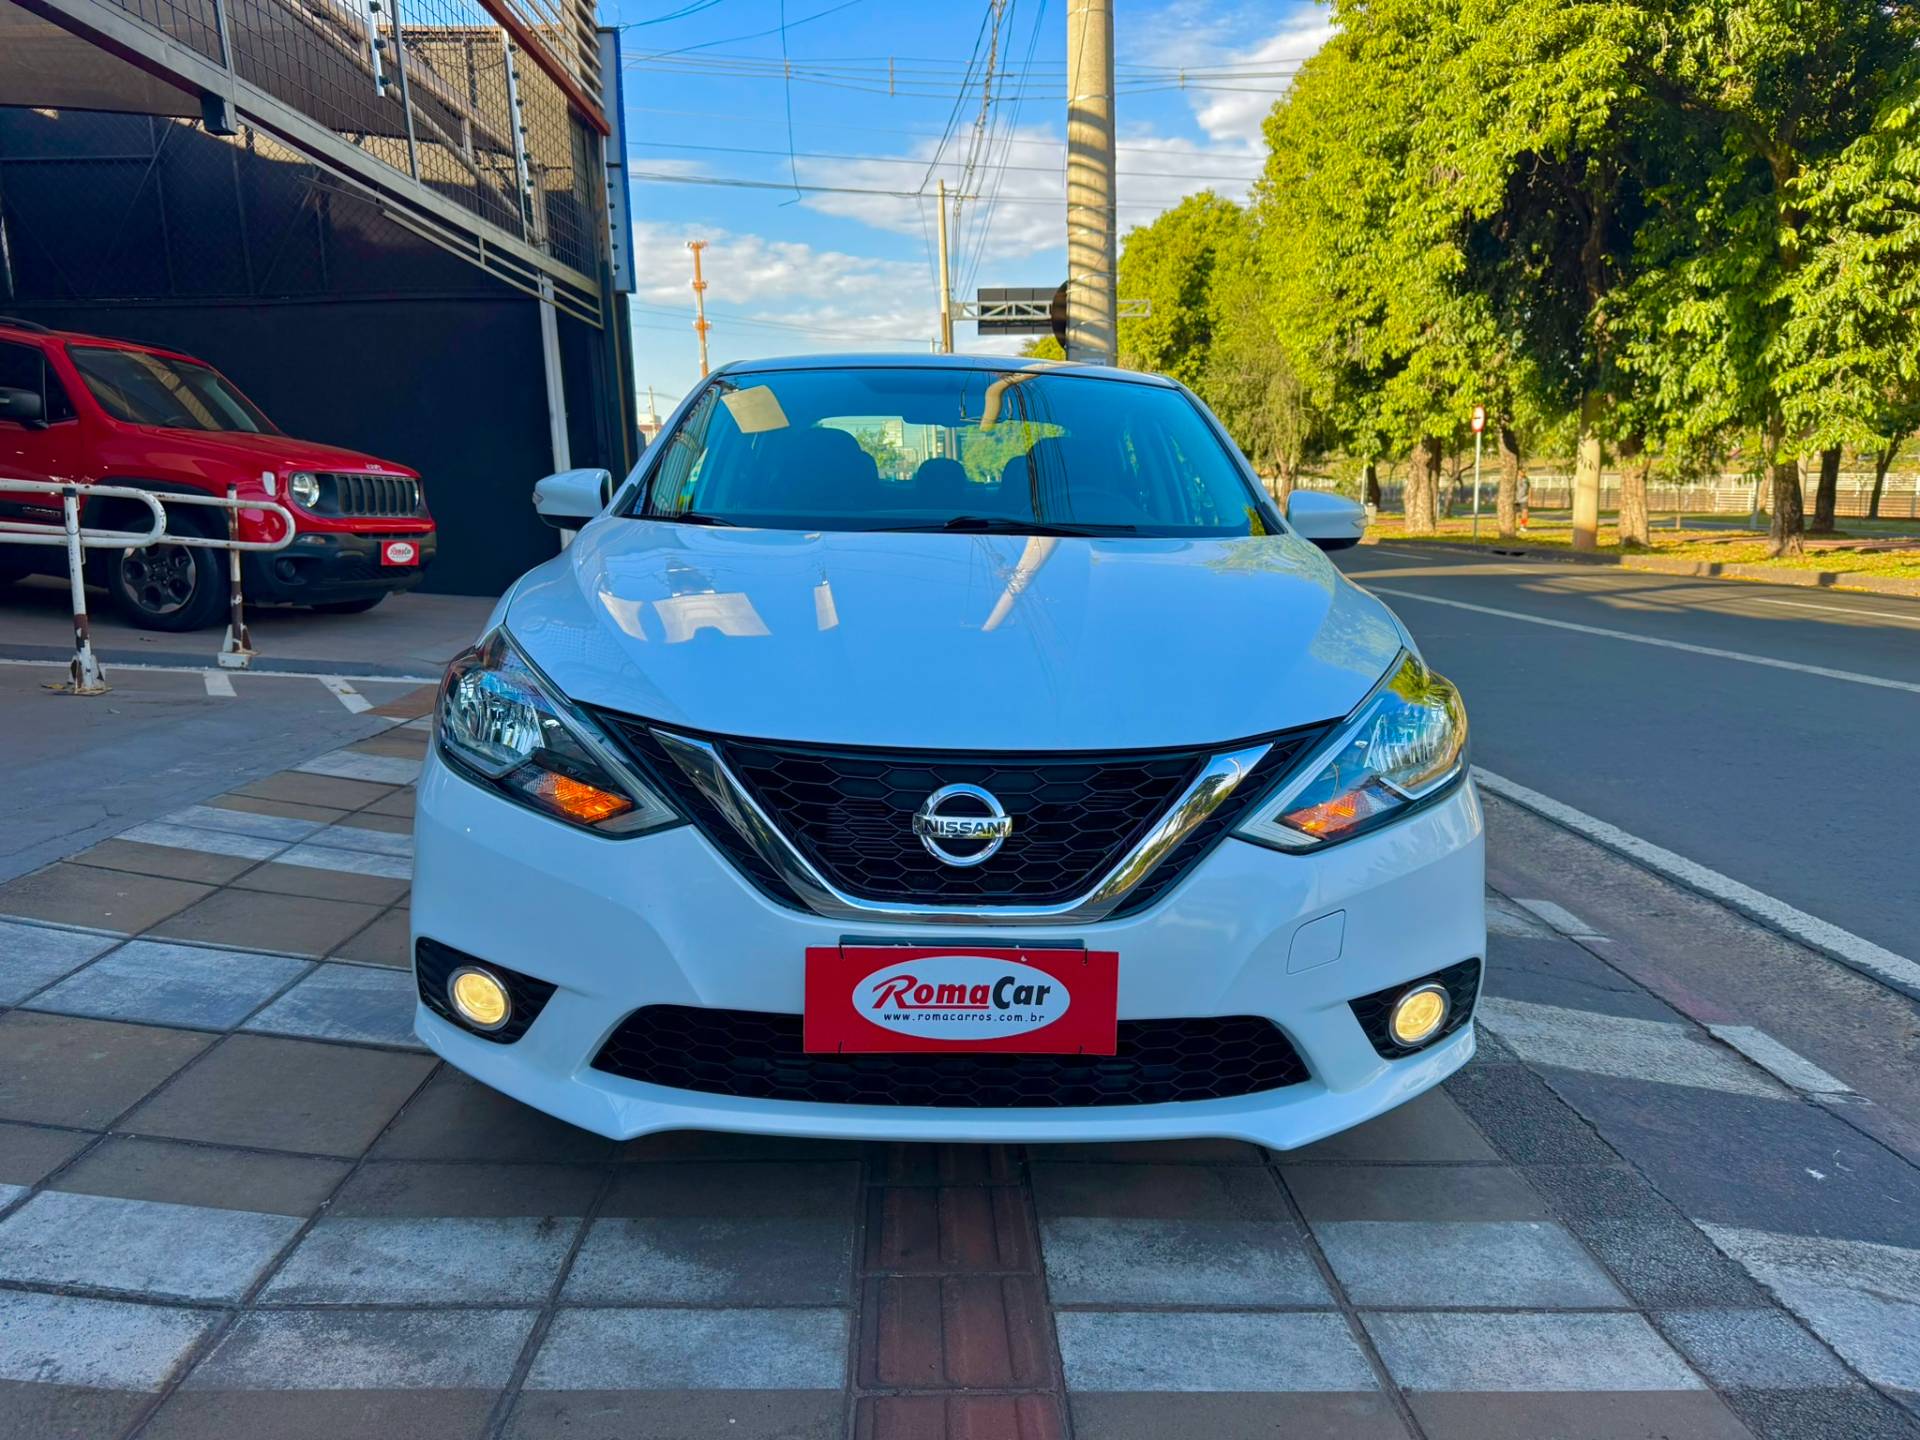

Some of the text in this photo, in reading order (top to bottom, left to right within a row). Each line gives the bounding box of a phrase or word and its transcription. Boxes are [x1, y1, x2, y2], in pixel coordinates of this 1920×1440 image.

[921, 820, 1006, 834] NISSAN
[872, 974, 1052, 1010] RomaCar
[883, 1012, 1045, 1023] www.romacarros.com.br
